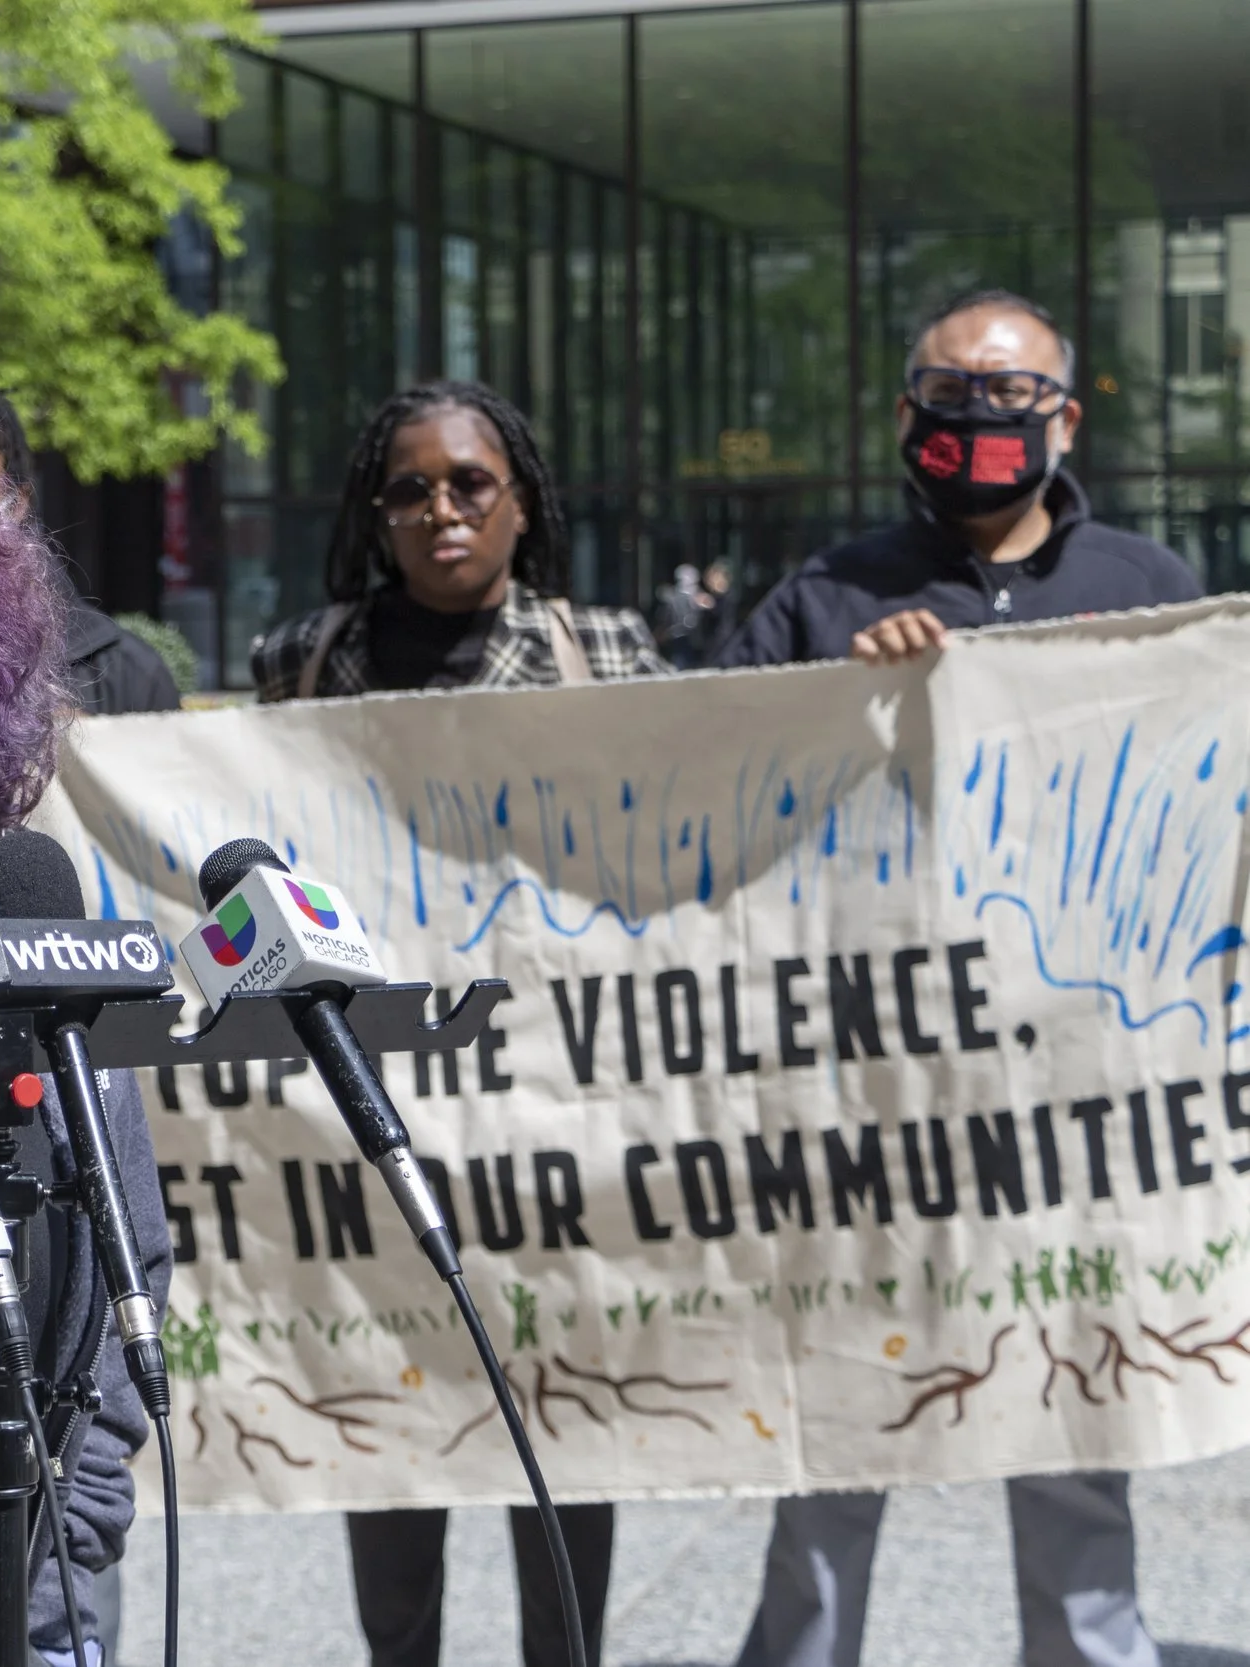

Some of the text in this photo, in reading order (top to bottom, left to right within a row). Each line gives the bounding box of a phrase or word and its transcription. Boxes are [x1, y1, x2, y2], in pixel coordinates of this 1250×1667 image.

[4, 933, 123, 971] wttw
[302, 930, 369, 957] NOTICIAS
[314, 945, 370, 968] CHICAGO
[230, 938, 286, 992] OTICIAS
[281, 1160, 375, 1258] IN
